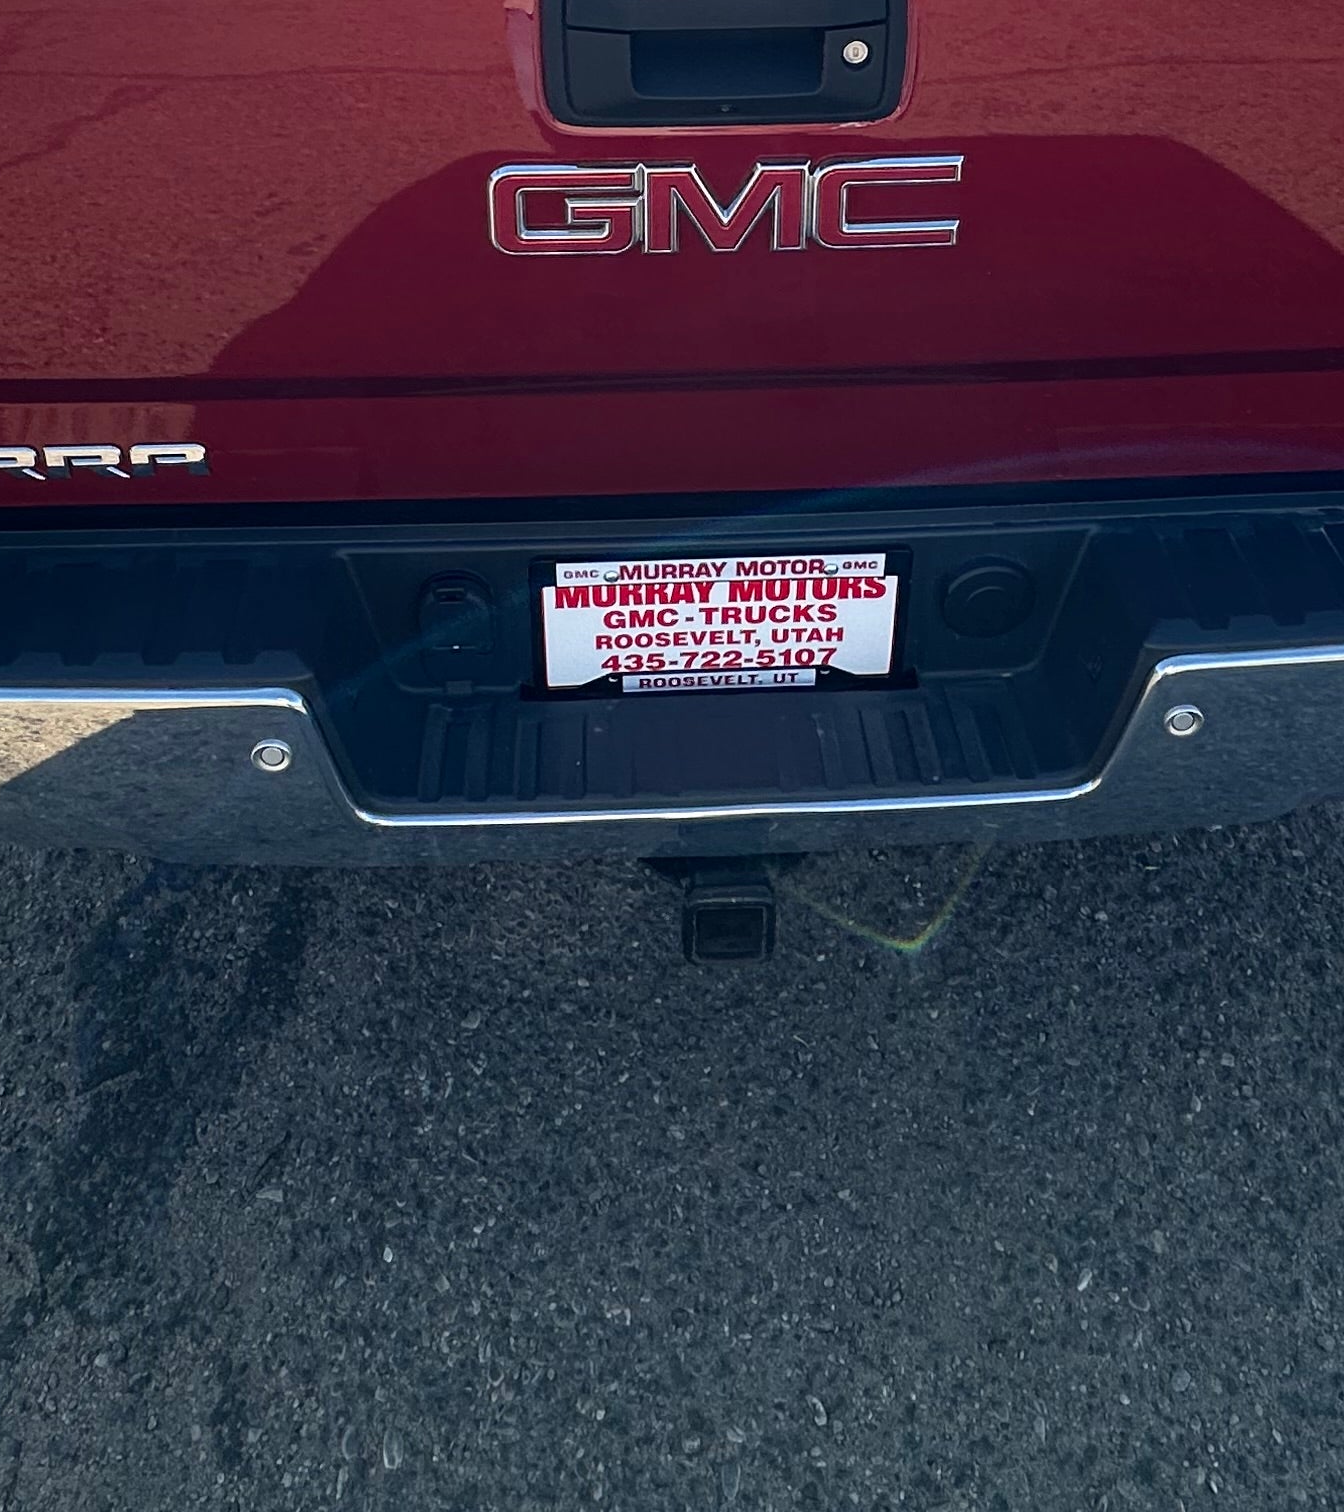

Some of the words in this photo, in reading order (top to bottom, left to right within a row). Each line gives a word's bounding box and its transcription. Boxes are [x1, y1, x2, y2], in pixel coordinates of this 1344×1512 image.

[489, 155, 965, 255] GMC
[563, 569, 599, 579] GMC
[619, 561, 727, 581] MURRAY
[736, 558, 825, 577] MOTOR
[842, 560, 878, 570] GMC
[555, 581, 717, 609] MURRAY
[728, 578, 887, 603] MOTORS
[604, 608, 679, 629] GMC
[699, 603, 838, 625] TRUCKS
[596, 628, 761, 650] ROOSEVELT,
[771, 627, 844, 644] UTAH
[601, 647, 838, 672] 435-722-5107
[774, 673, 799, 685] UT
